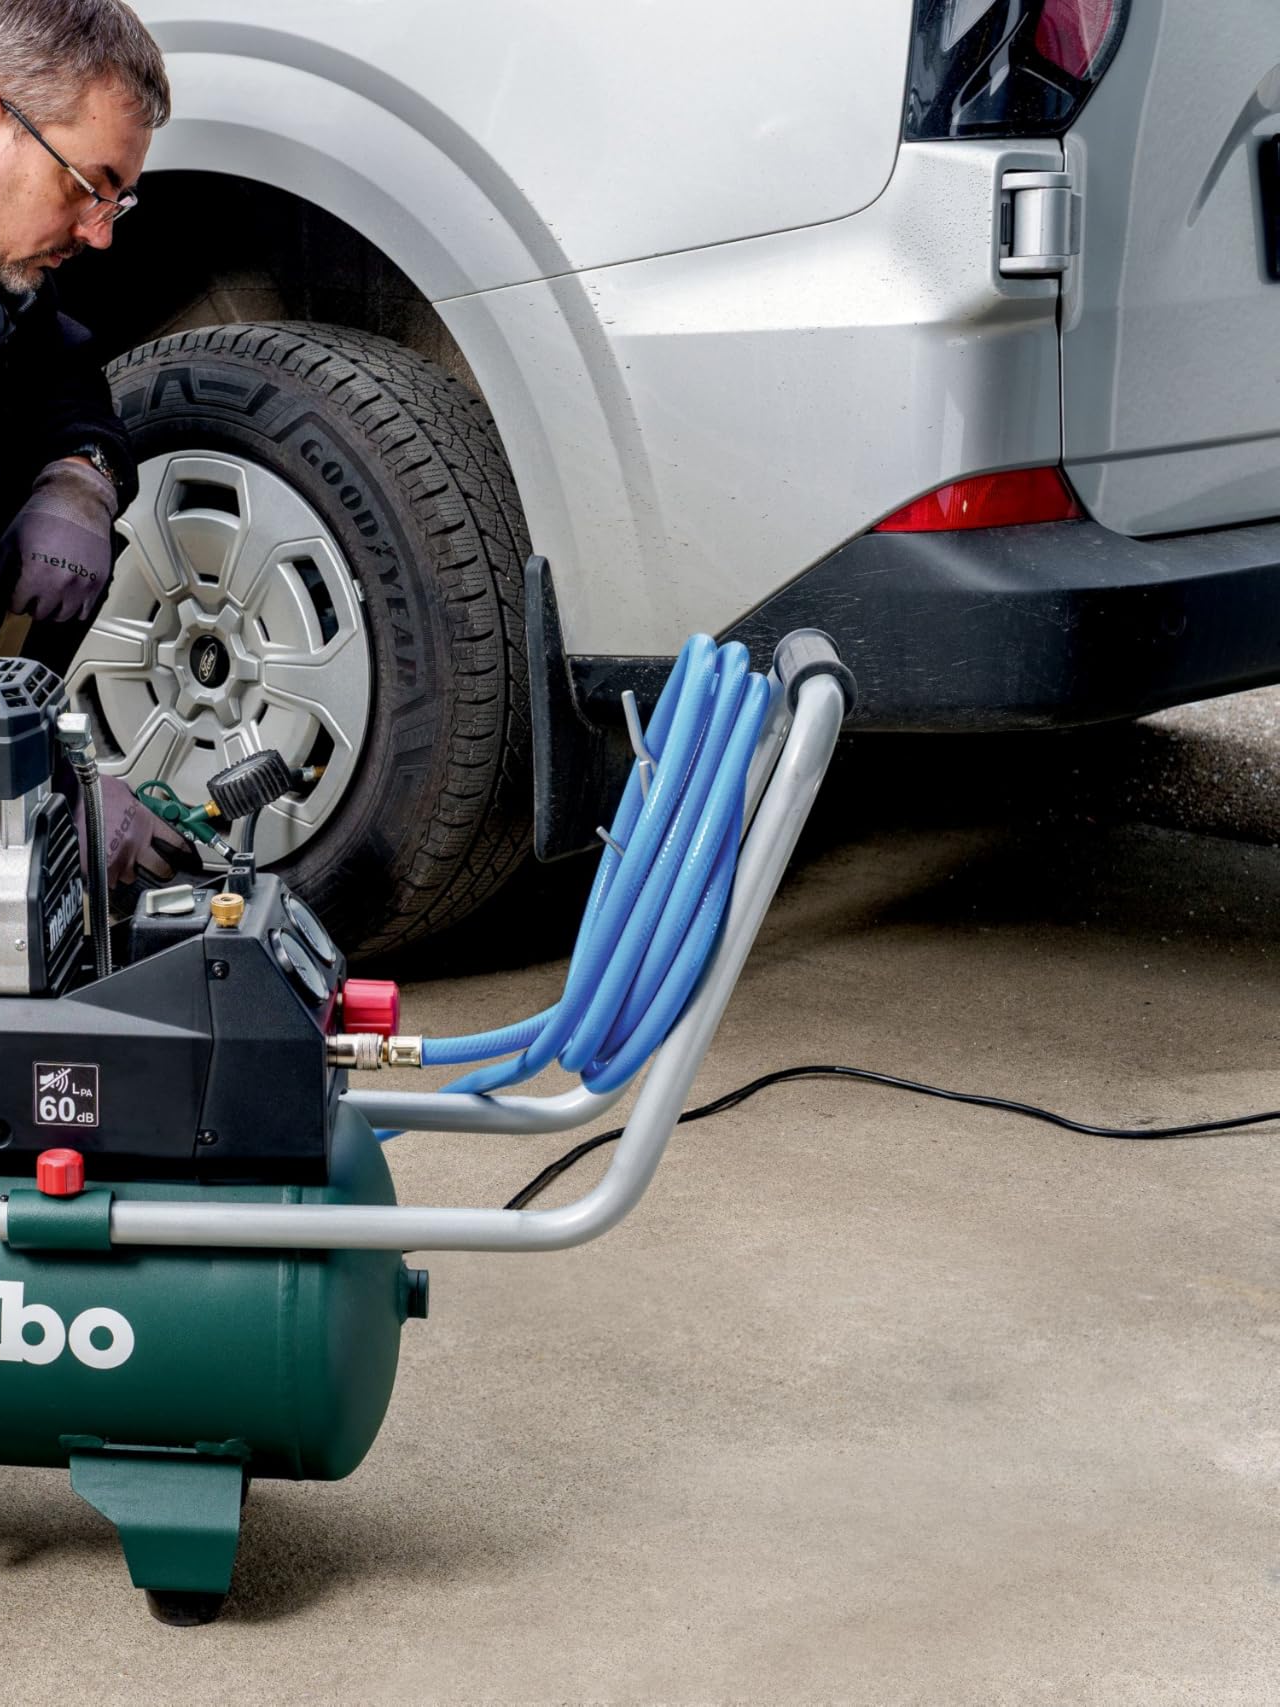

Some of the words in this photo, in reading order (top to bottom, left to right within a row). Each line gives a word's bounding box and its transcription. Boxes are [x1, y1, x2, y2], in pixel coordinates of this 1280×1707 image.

[31, 552, 97, 582] metabo
[300, 439, 418, 687] GOODYEAR
[49, 878, 83, 952] metabo
[39, 1095, 76, 1122] 60
[76, 1112, 94, 1123] dB
